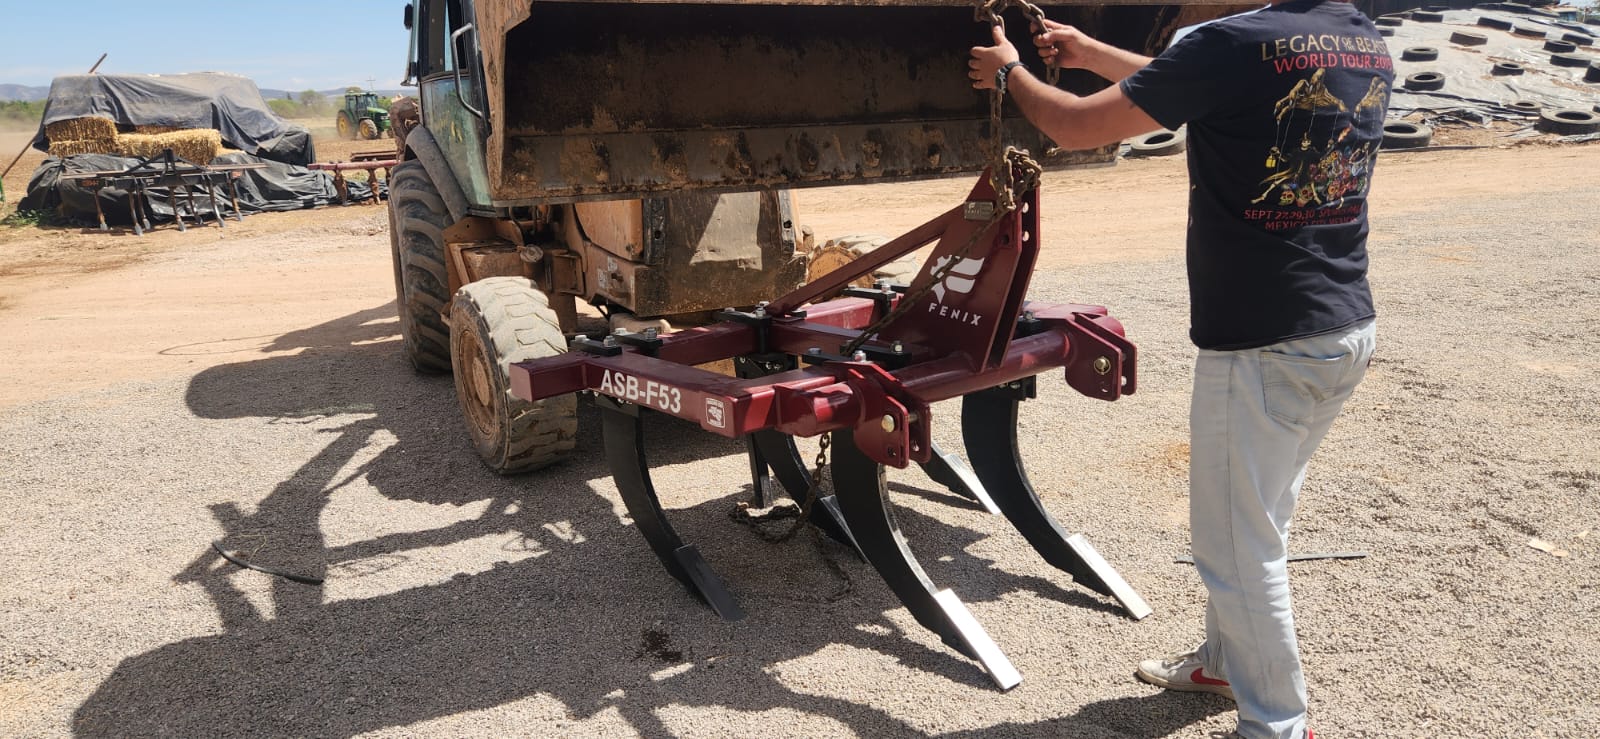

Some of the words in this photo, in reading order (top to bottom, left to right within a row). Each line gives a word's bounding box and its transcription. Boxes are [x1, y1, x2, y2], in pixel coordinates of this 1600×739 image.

[1261, 34, 1340, 62] LEGACY
[1274, 53, 1338, 74] WORLD
[1340, 53, 1371, 69] TOUR
[1244, 209, 1273, 220] SEPT
[928, 302, 982, 327] FENIX
[600, 368, 682, 414] ASB-F53
